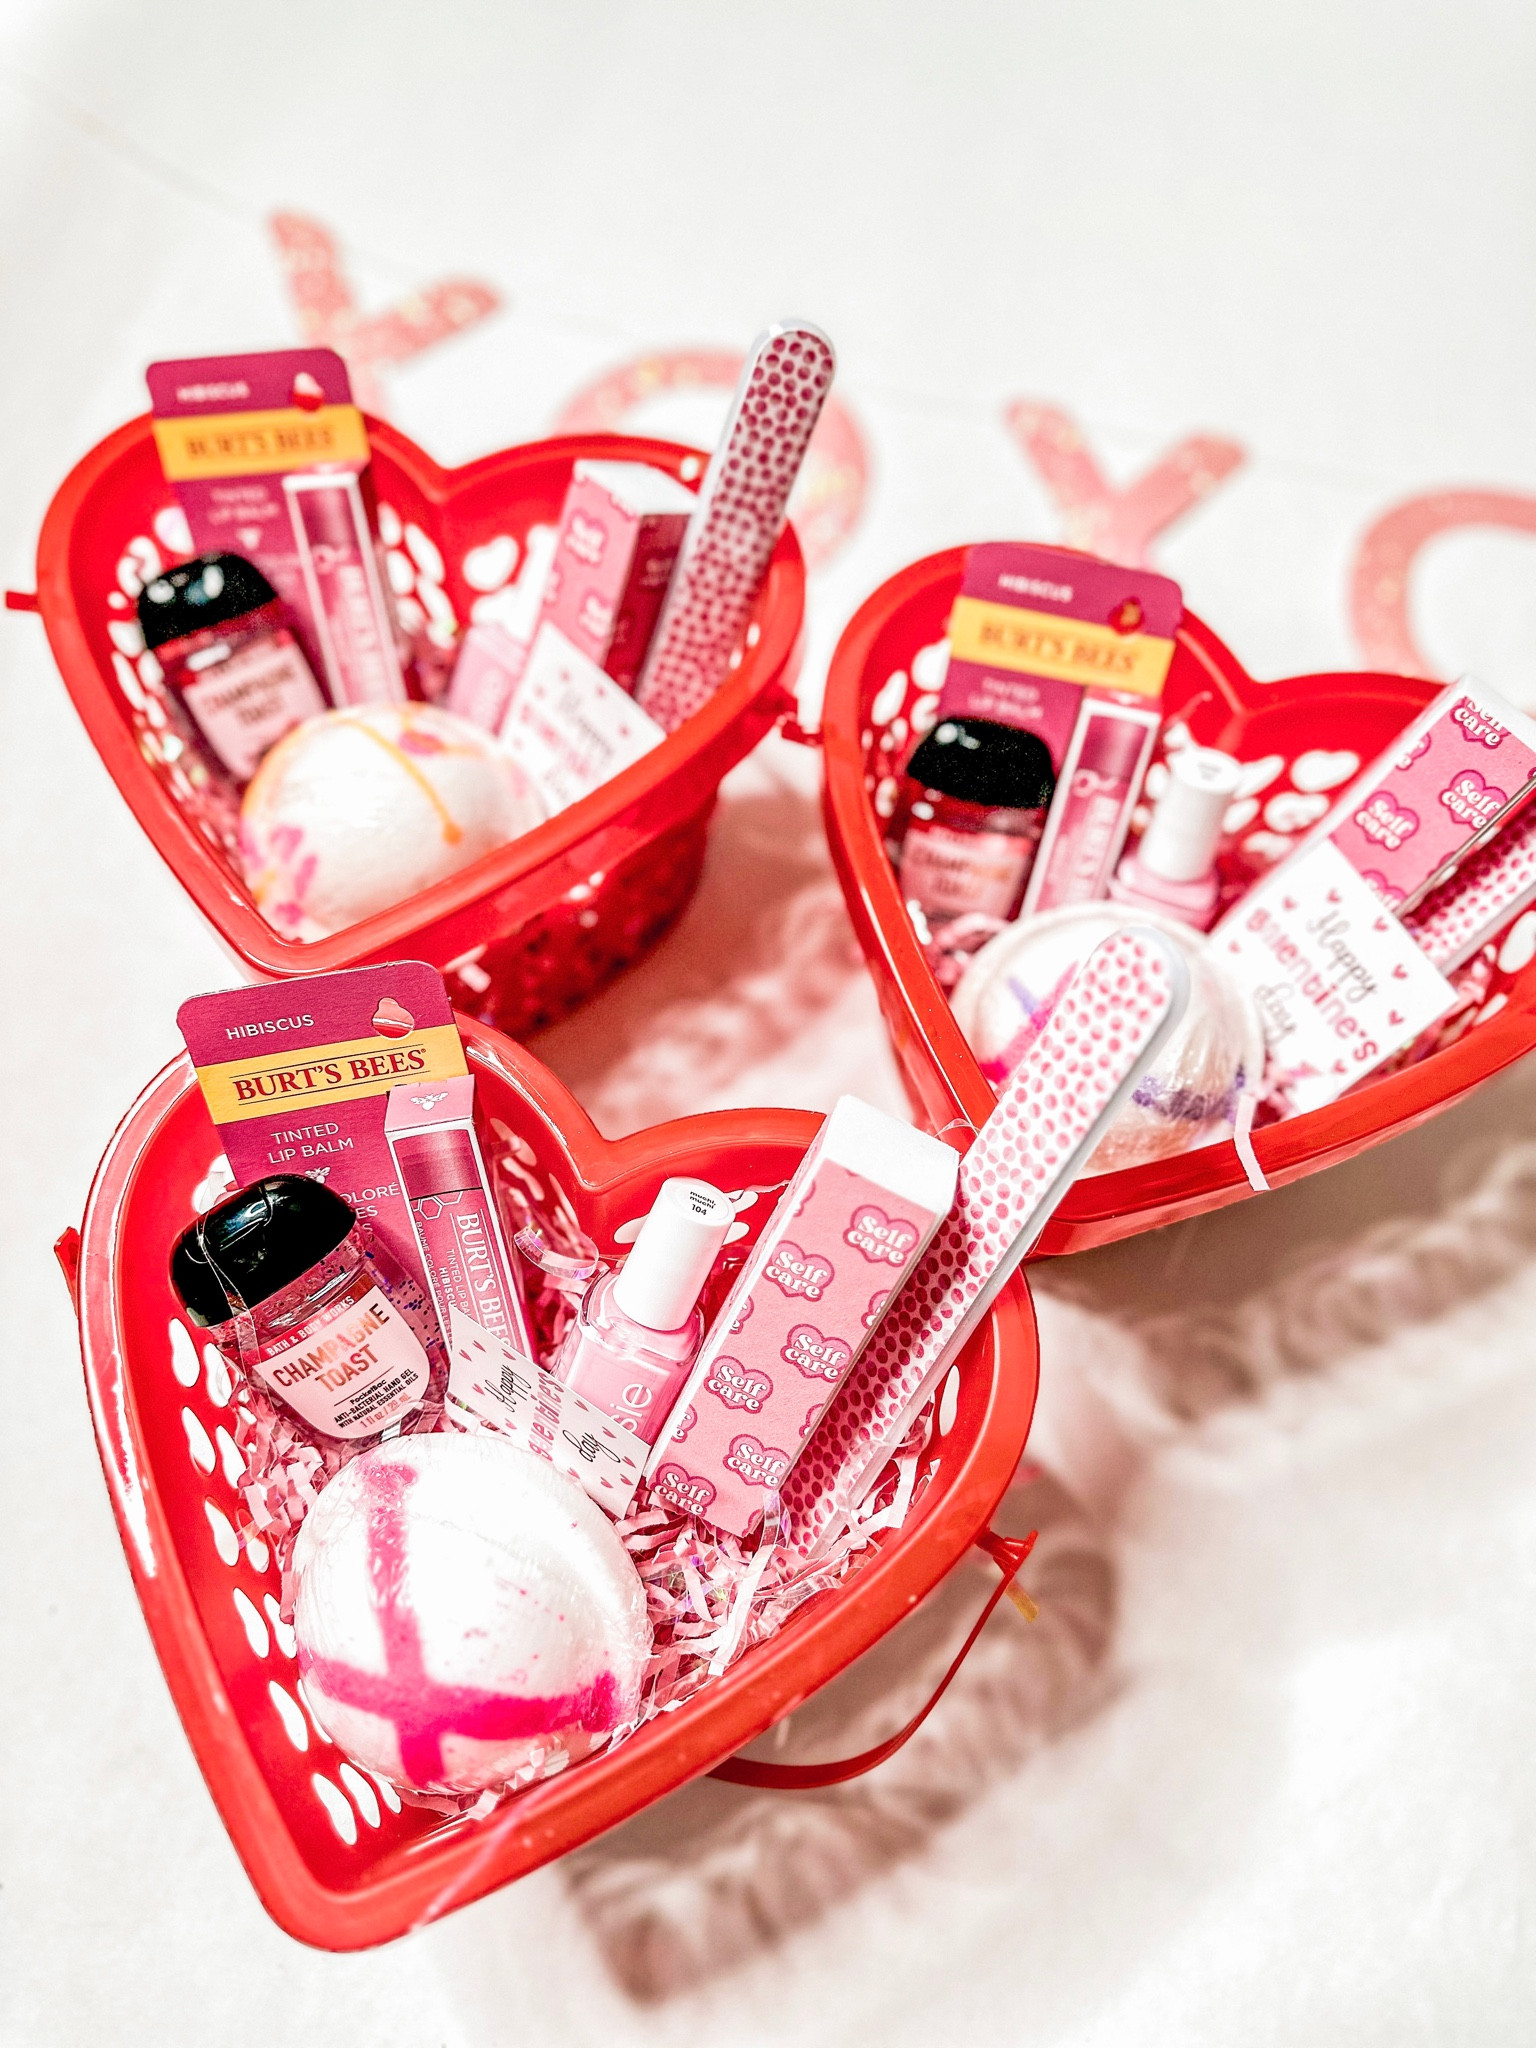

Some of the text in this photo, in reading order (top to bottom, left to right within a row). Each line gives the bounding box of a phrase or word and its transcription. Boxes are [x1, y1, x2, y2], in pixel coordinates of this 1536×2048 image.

[1454, 707, 1500, 746] care
[1441, 791, 1487, 829] care
[1455, 779, 1500, 815] Self
[1368, 799, 1414, 836] Self
[225, 1014, 315, 1041] HIBISCUS
[232, 1063, 343, 1101] BURT'S
[268, 1137, 354, 1164] LIP BALM
[270, 1122, 340, 1145] TINTED
[692, 1203, 707, 1216] 104
[847, 1230, 904, 1264] care
[858, 1215, 913, 1249] Self
[457, 1213, 496, 1293] BURT'S
[775, 1251, 828, 1284] Self
[438, 1267, 457, 1308] HIBISCU
[446, 1249, 461, 1282] TINTED
[456, 1284, 467, 1298] LIP
[765, 1265, 821, 1299] care
[266, 1295, 355, 1357] BATH & BODY WORKS
[272, 1303, 390, 1387] CHAMPAGNE
[794, 1333, 846, 1366] Self
[315, 1344, 379, 1392] TOAST
[717, 1365, 767, 1397] Self
[784, 1348, 839, 1380] care
[334, 1368, 414, 1423] ANTI-BACTERIAL HAND GEL
[338, 1373, 419, 1428] WITH NATURAL ESSENTIAL OILS
[350, 1379, 387, 1405] PocketBac
[484, 1364, 532, 1413] Happy
[707, 1379, 760, 1410] care
[609, 1383, 652, 1432] sie
[562, 1429, 621, 1464] day
[736, 1443, 786, 1474] Self
[663, 1472, 711, 1502] Self
[727, 1456, 779, 1487] care
[654, 1484, 704, 1515] care
